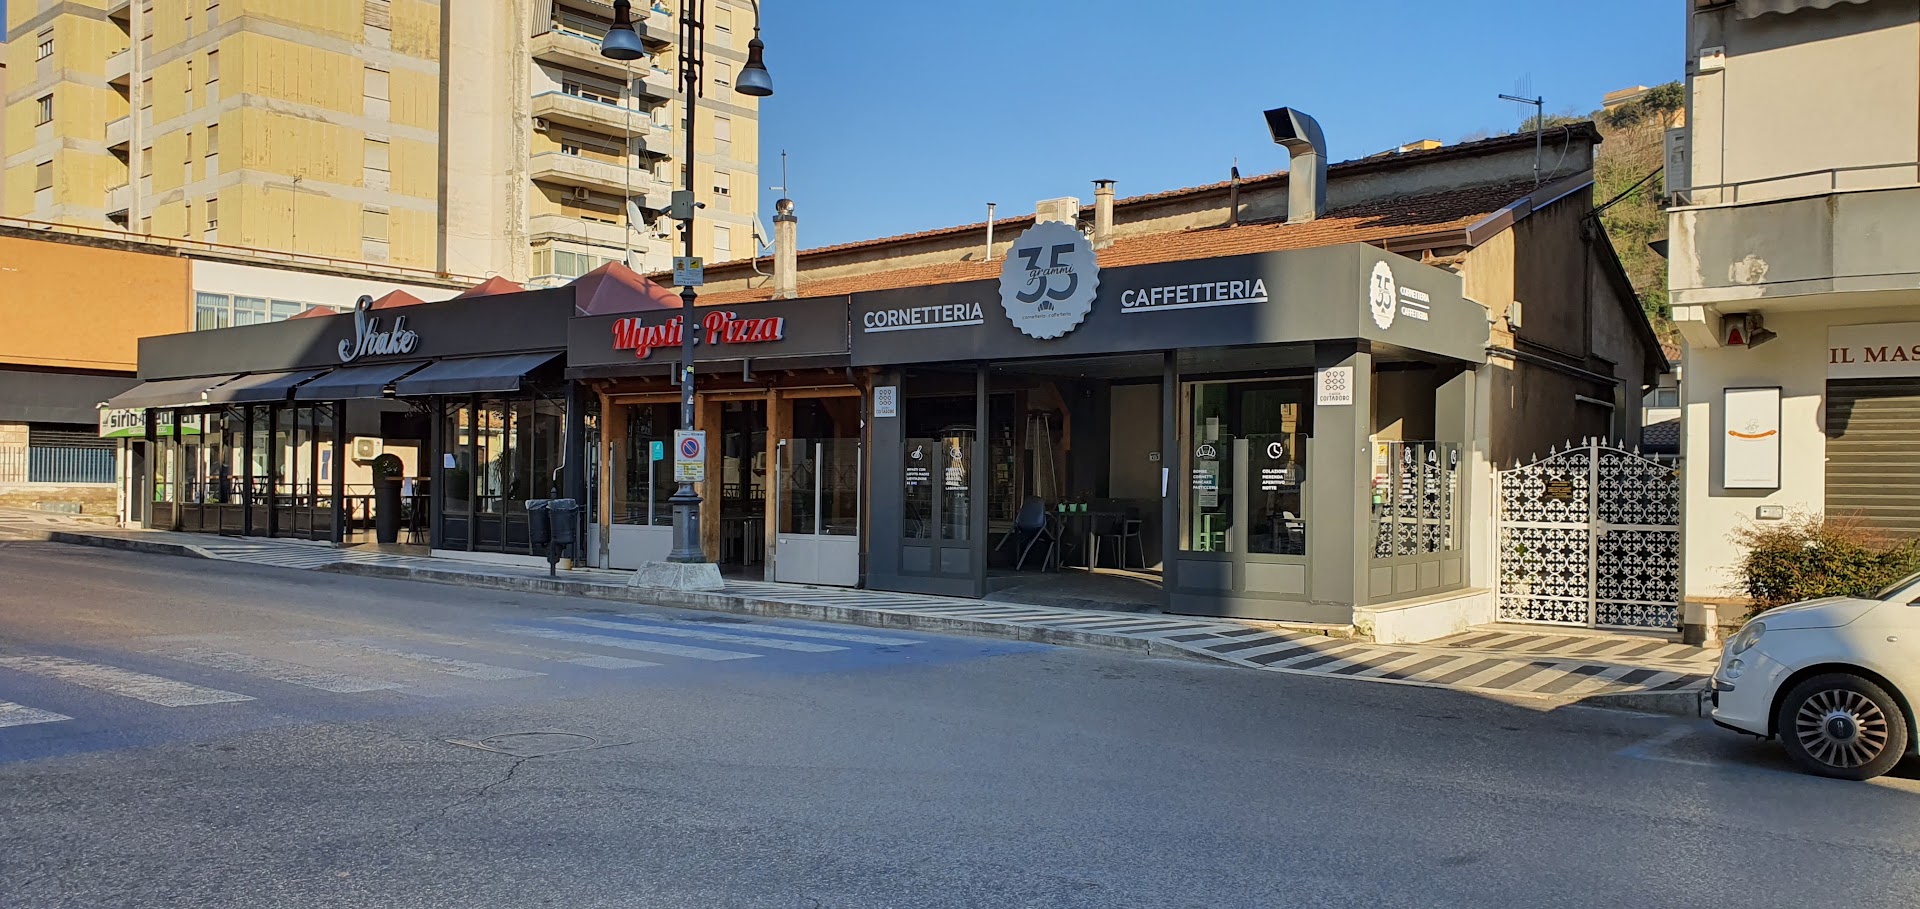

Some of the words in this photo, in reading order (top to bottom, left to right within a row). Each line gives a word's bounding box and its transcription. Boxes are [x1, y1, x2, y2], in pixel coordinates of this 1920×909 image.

[1015, 243, 1079, 303] 35
[1026, 264, 1075, 286] grammi
[1121, 278, 1268, 308] CAFFETTERIA
[1375, 274, 1391, 310] 35
[338, 295, 418, 362] Shake
[863, 302, 984, 328] CORNETTERIA
[612, 315, 700, 359] Mysti
[703, 311, 784, 345] Pizza
[1829, 347, 1855, 364] IL
[1863, 345, 1920, 363] MAS
